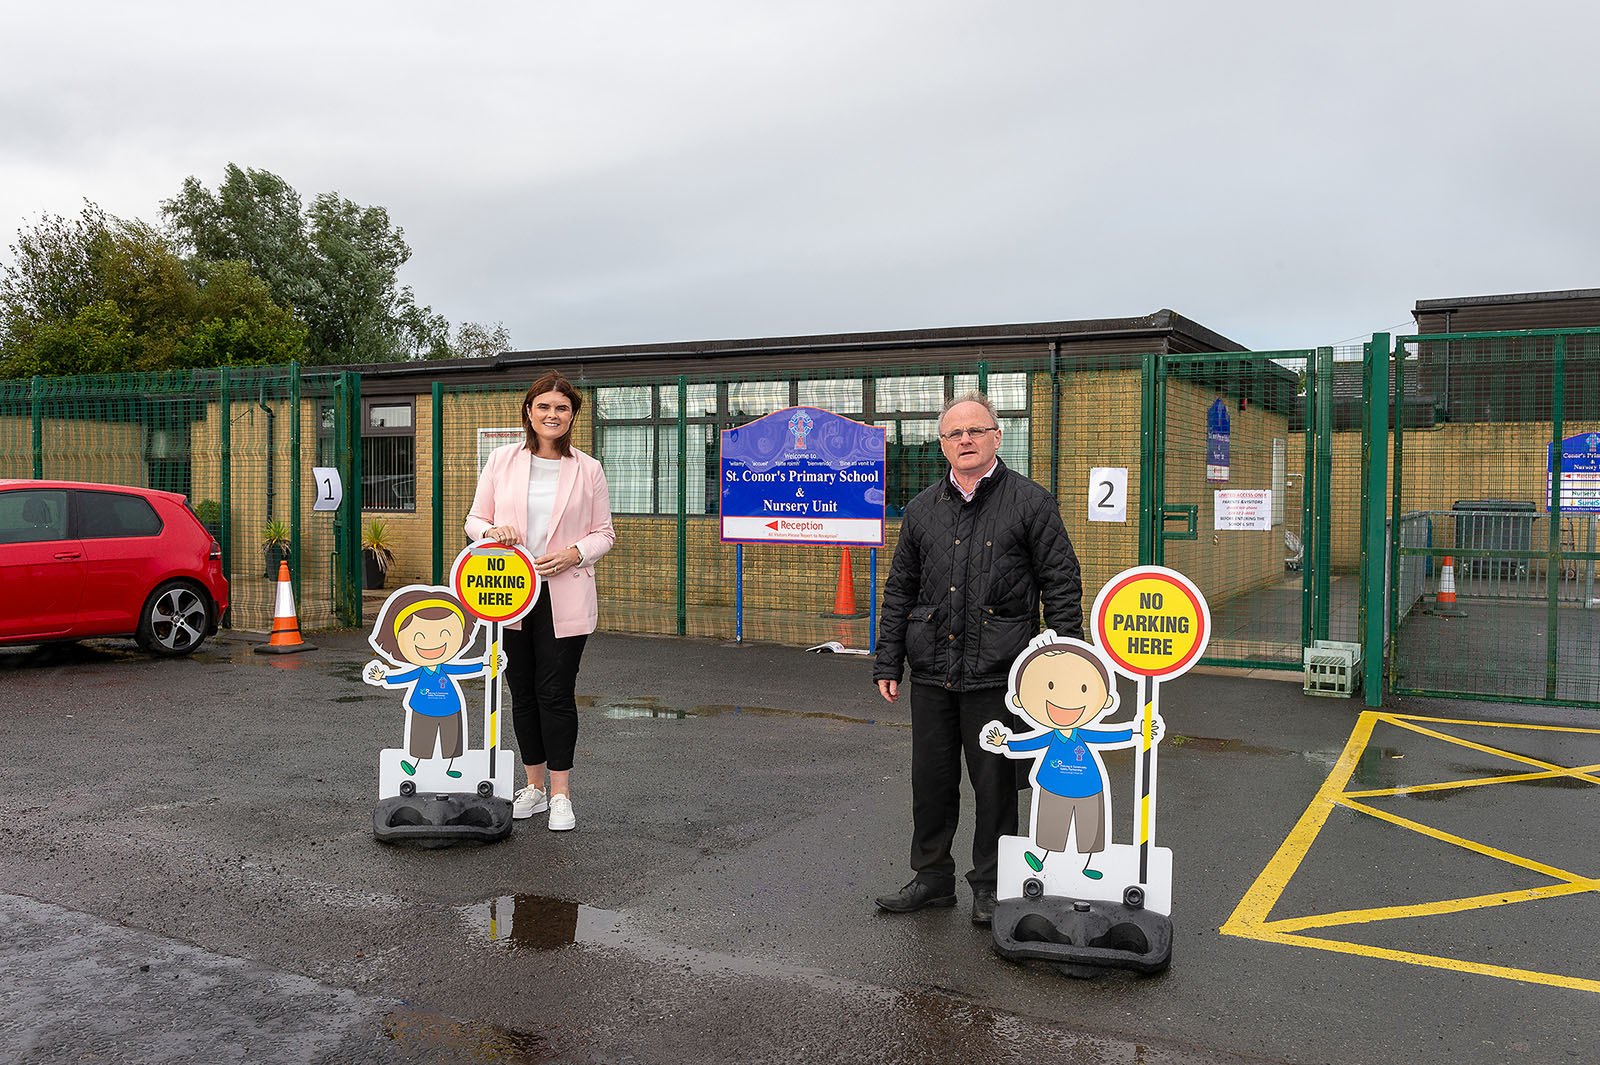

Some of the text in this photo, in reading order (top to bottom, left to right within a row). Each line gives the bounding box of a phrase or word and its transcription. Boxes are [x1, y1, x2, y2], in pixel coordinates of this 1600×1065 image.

[726, 470, 879, 485] St. Conor's Primary School
[324, 478, 334, 500] 1
[795, 488, 805, 498] &
[1098, 480, 1114, 508] 2
[763, 499, 838, 514] Nursery Unit
[780, 520, 824, 531] Reception
[488, 558, 505, 571] NO
[467, 575, 524, 588] PARKING
[478, 592, 512, 606] HERE
[1140, 592, 1163, 610] NO
[1113, 614, 1190, 634] PARKING
[1128, 637, 1172, 655] HERE
